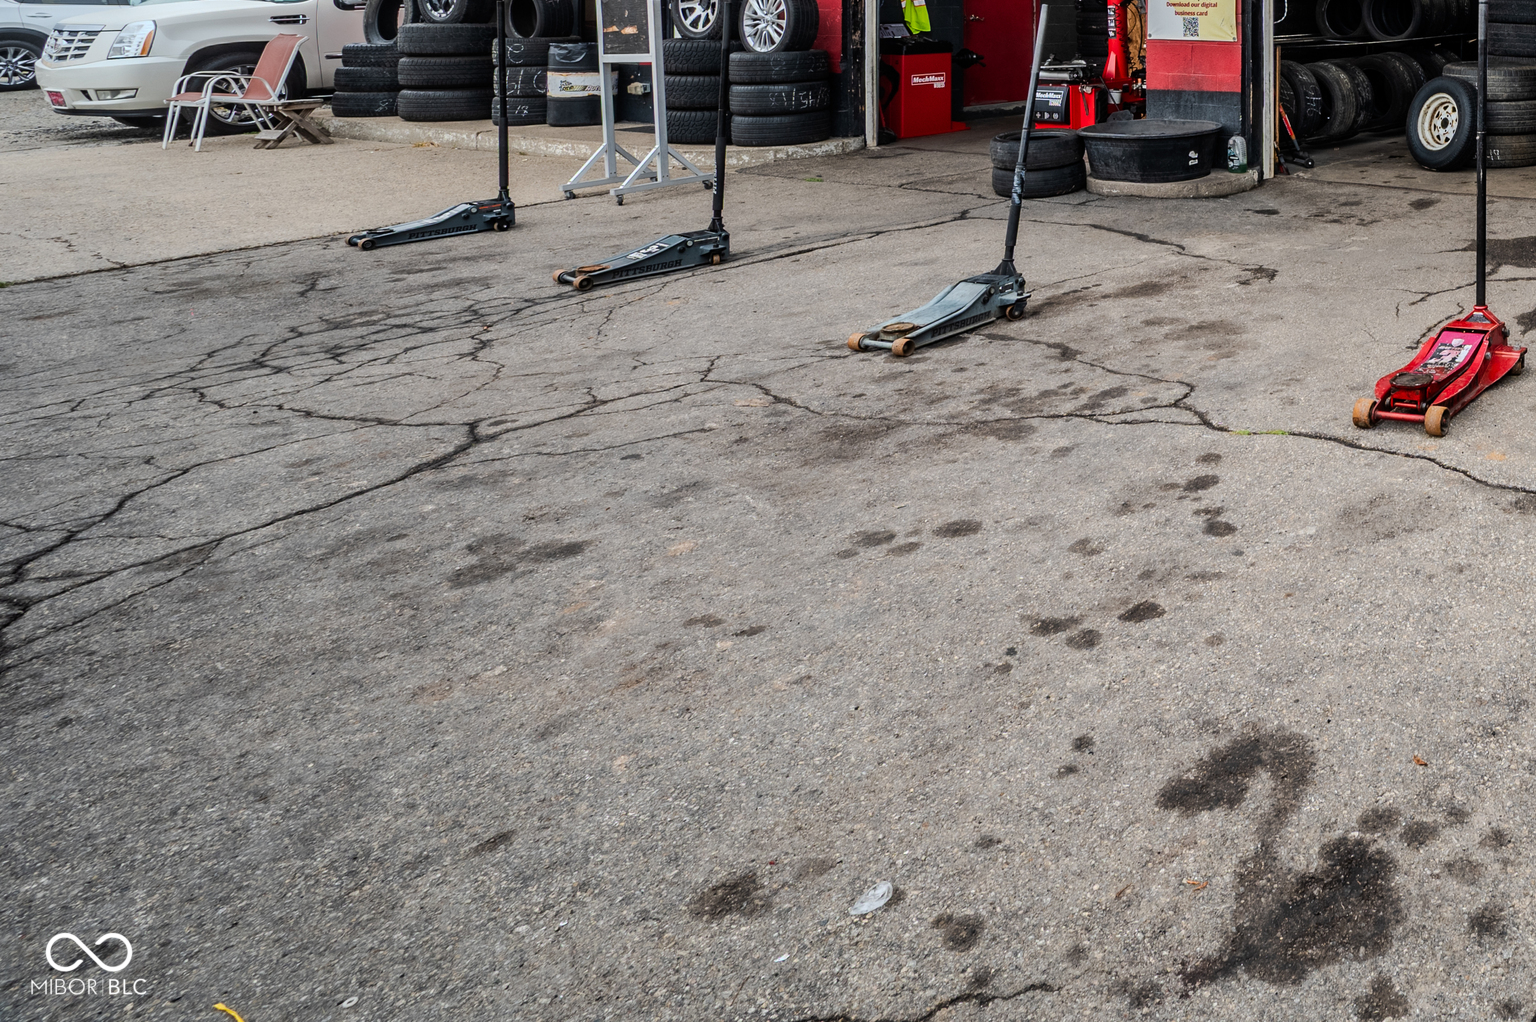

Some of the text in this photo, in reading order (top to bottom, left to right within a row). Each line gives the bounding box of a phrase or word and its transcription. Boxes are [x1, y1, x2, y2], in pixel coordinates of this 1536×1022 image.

[408, 224, 478, 239] PITTSBURGH
[612, 259, 682, 278] PITTSBURGH
[931, 310, 992, 338] PITTSBURGH
